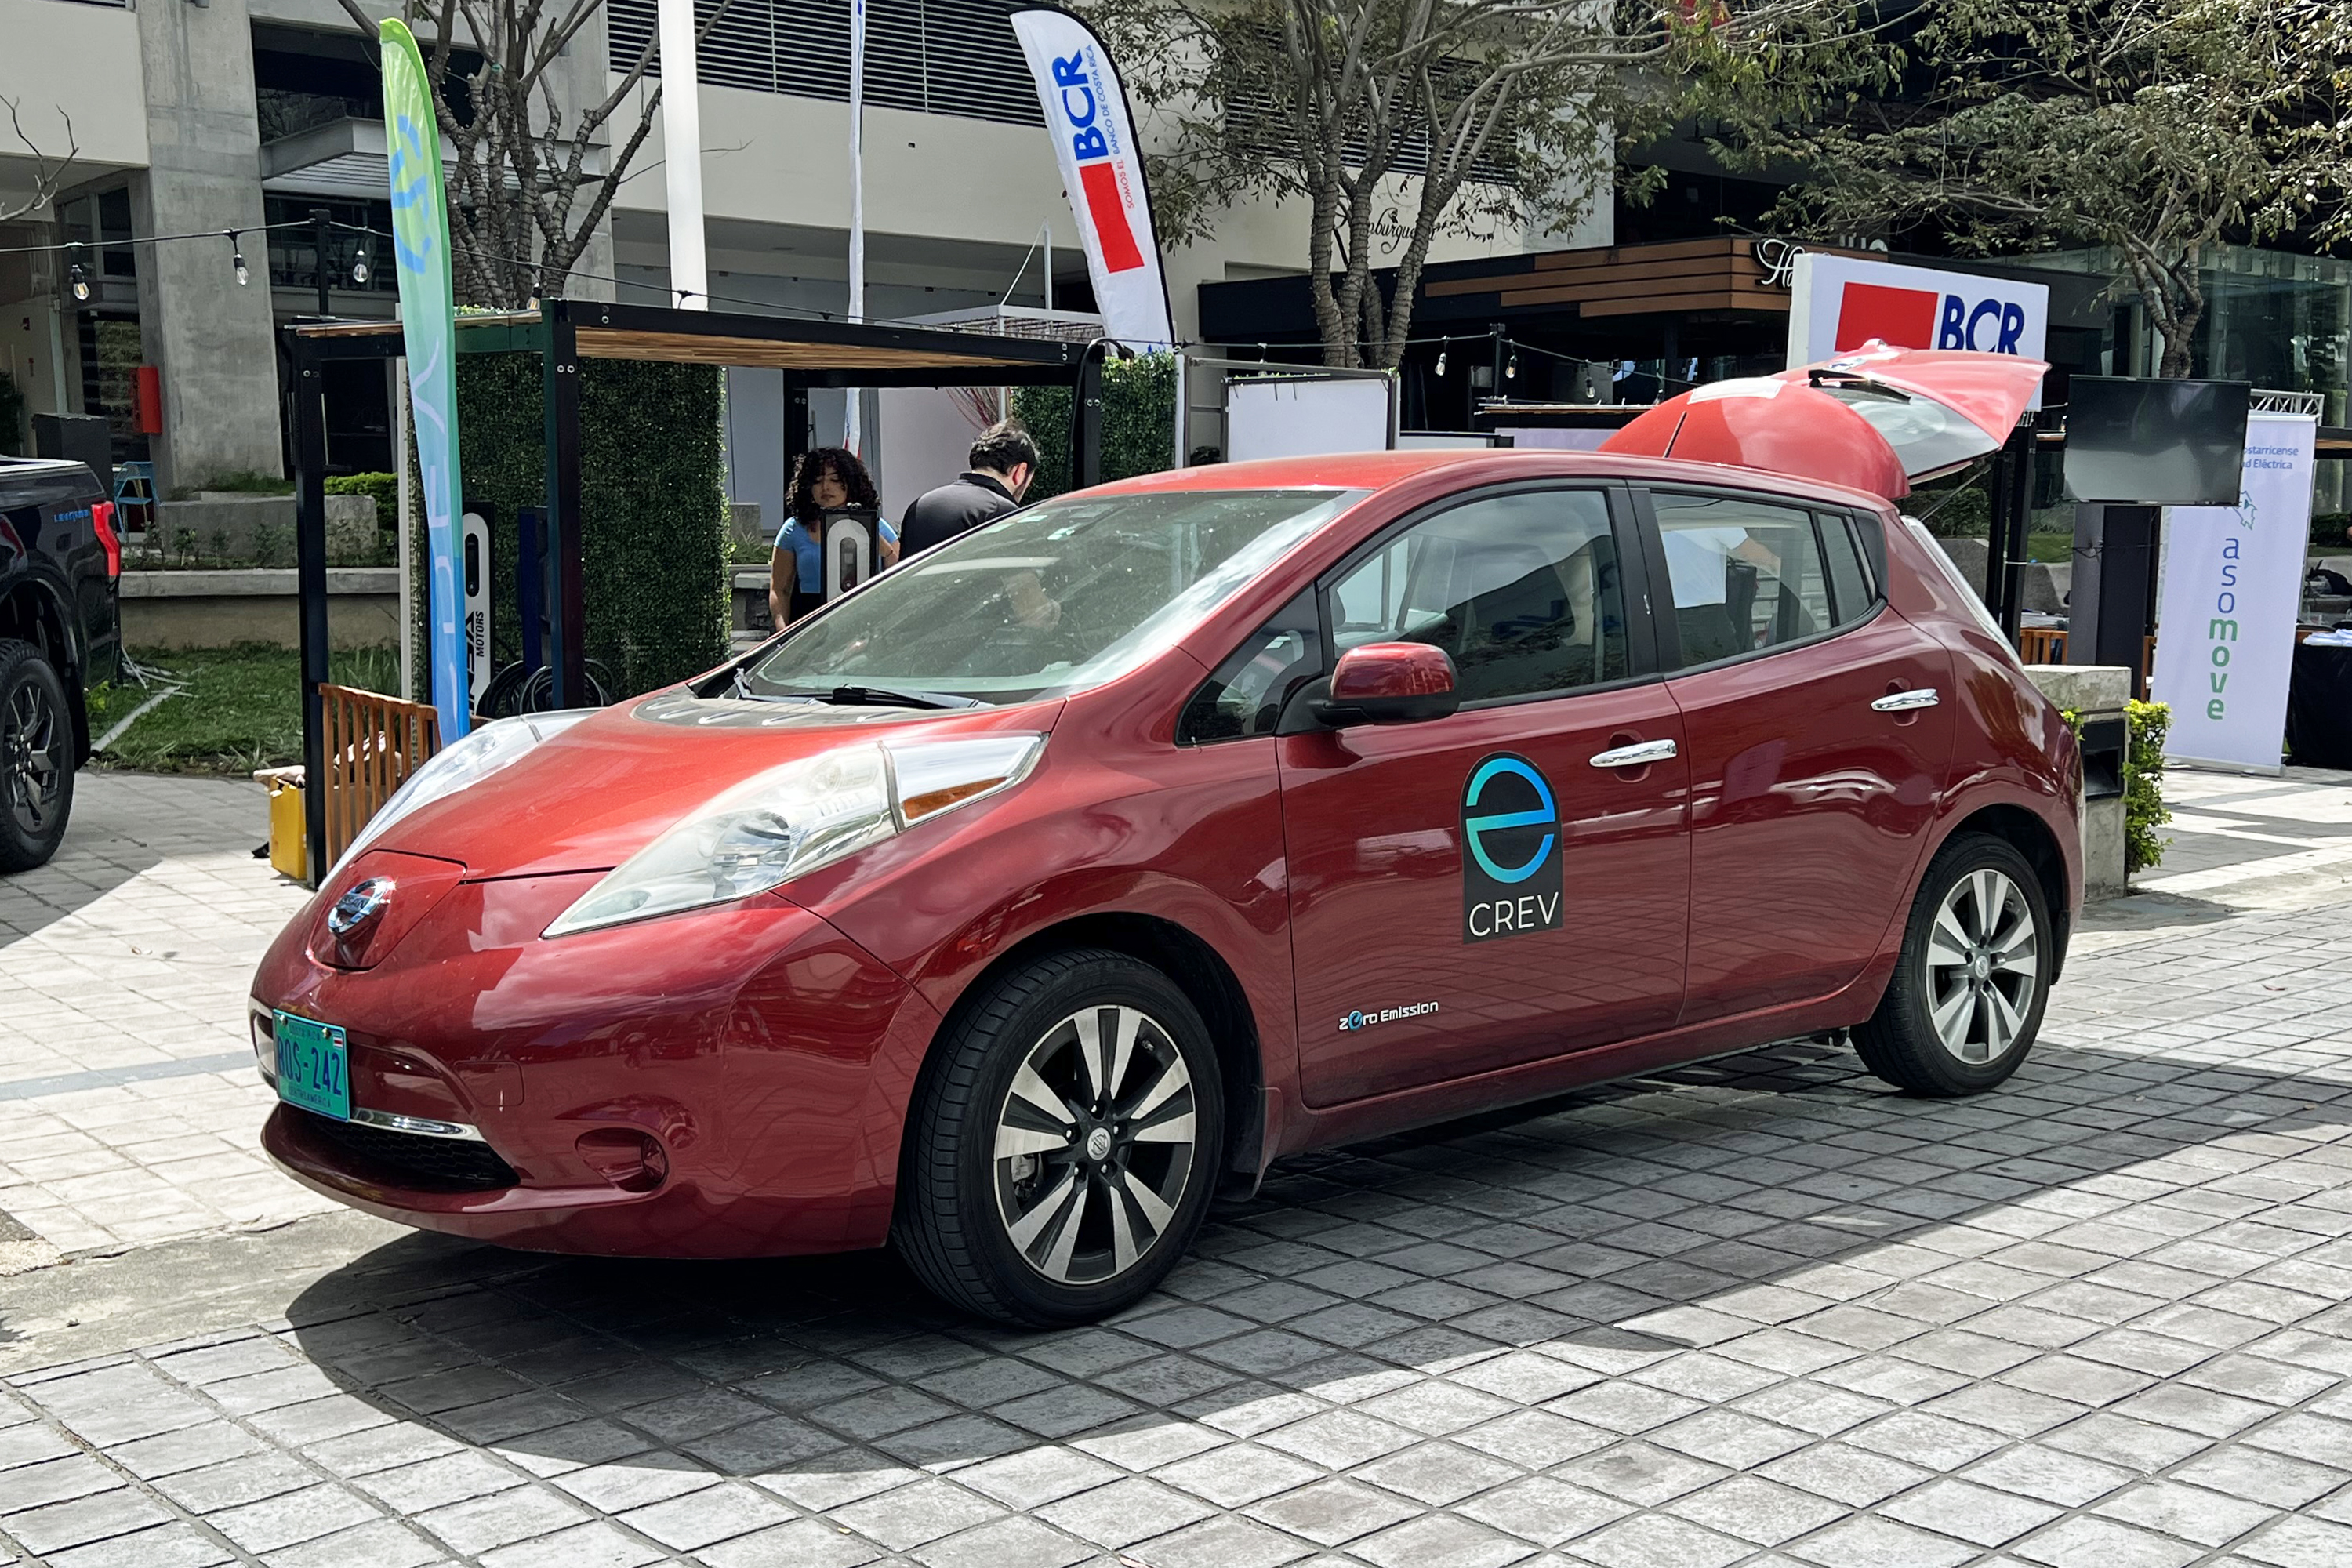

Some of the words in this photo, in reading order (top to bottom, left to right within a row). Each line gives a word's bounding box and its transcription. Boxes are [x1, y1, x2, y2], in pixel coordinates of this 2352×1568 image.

[1084, 44, 1098, 67] RICA
[1092, 69, 1107, 102] COSTA
[1051, 49, 1109, 161] BCR
[1099, 103, 1110, 117] DE
[1103, 118, 1120, 154] BANCO
[1116, 159, 1125, 169] EL
[1118, 172, 1135, 209] SOMOS
[1937, 294, 2025, 356] BCR
[2253, 459, 2293, 470] Eléctrica
[475, 611, 485, 657] MOTORS
[1468, 891, 1559, 937] CREV
[1380, 1001, 1439, 1022] Emission
